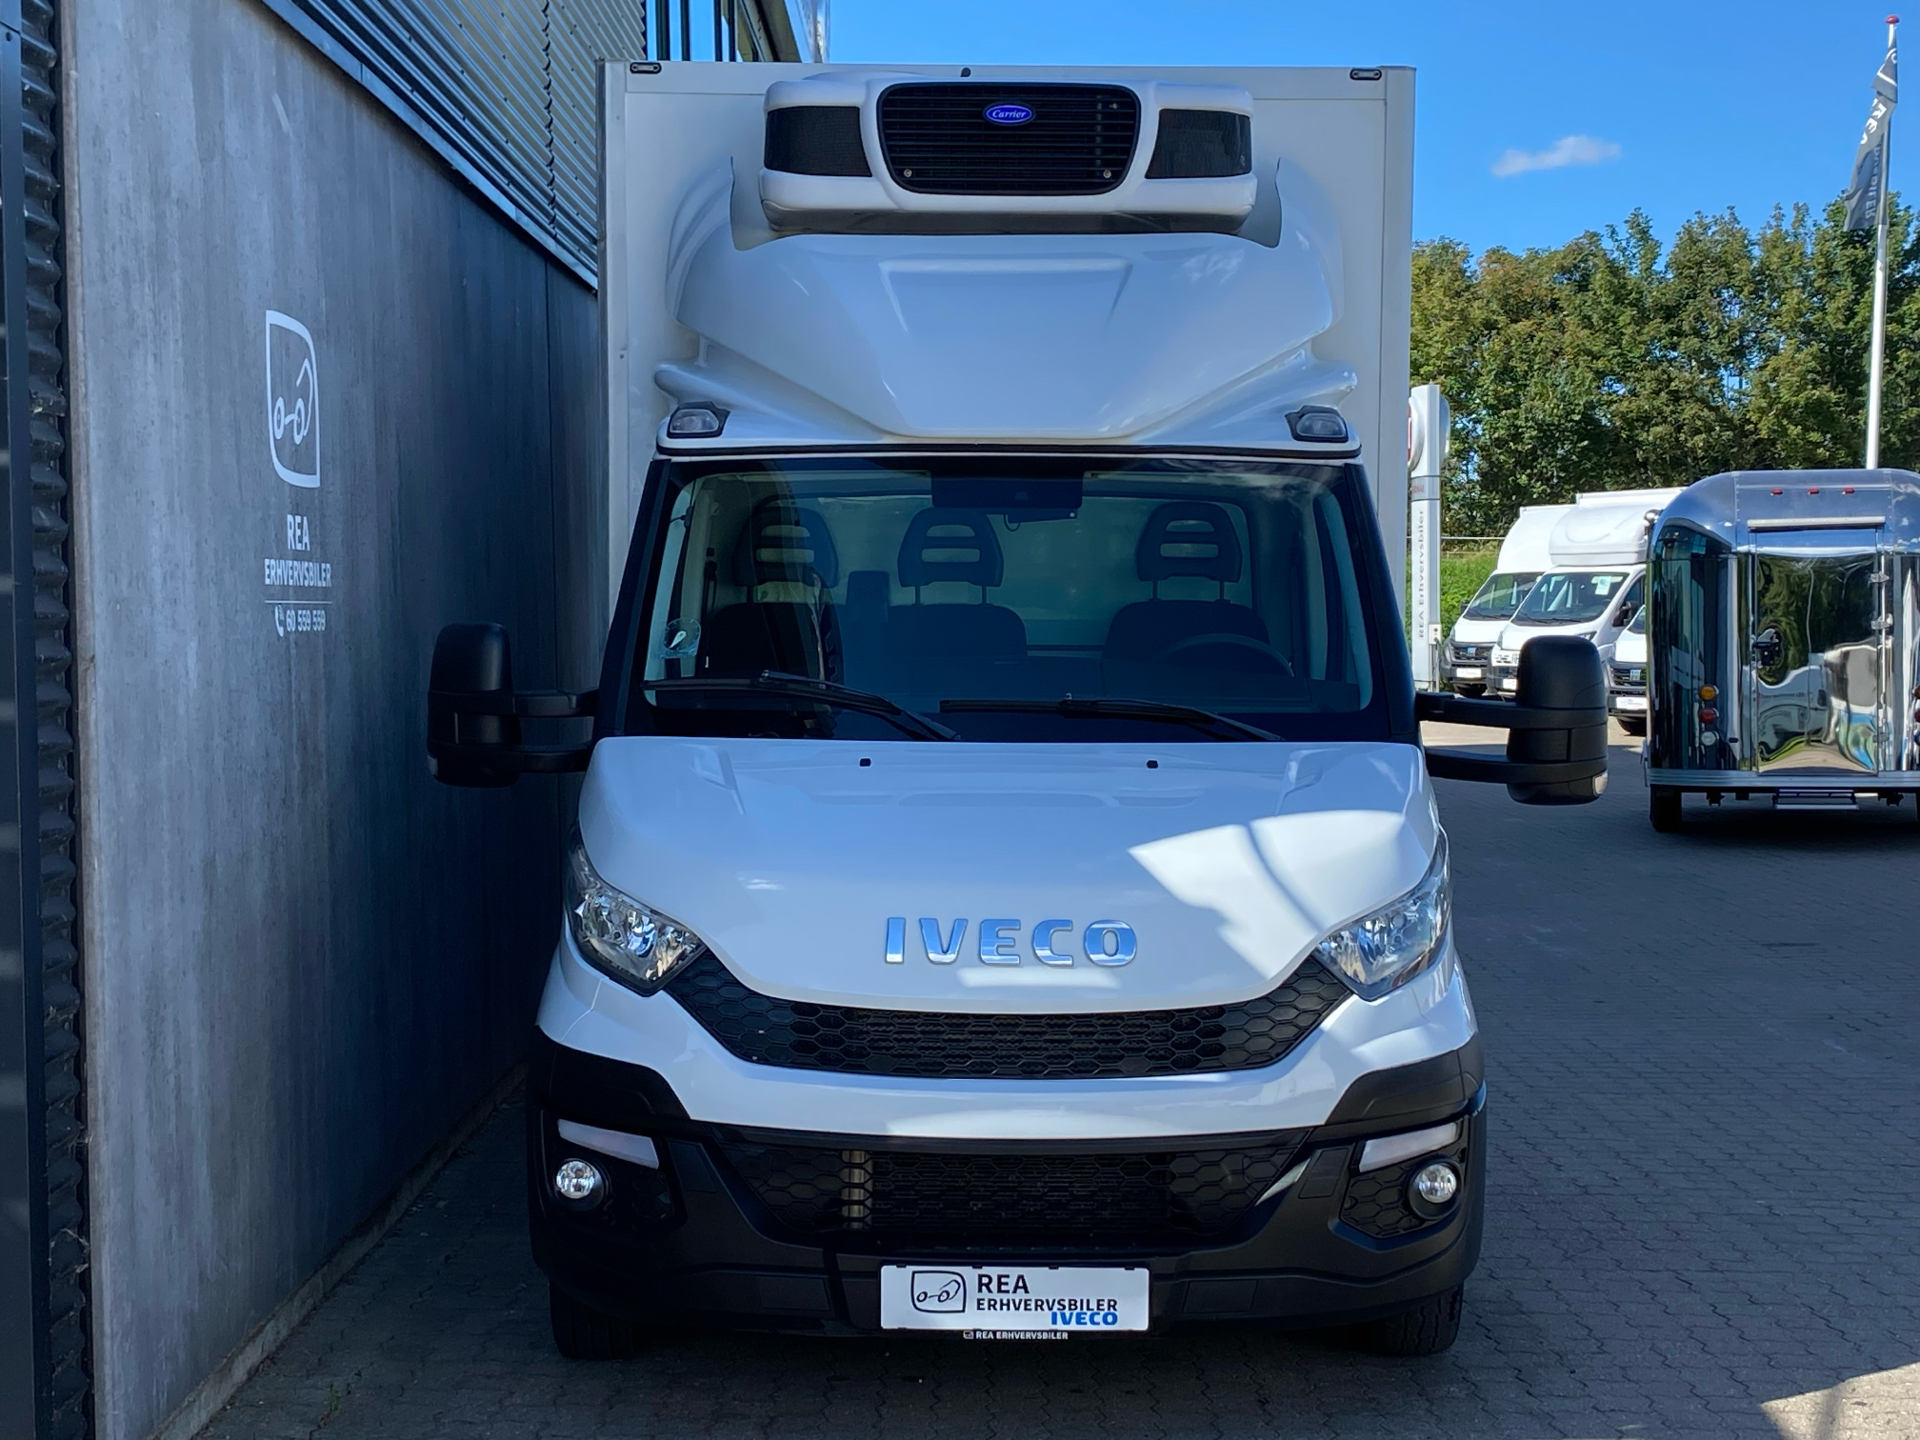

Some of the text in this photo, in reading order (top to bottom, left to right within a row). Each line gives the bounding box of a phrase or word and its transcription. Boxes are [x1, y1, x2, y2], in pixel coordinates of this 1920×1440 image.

[992, 109, 1026, 119] Carrier
[286, 514, 311, 551] REA
[1417, 510, 1425, 606] Erhvervsbiler
[264, 558, 332, 588] ERHVERVSBILER
[286, 609, 296, 632] 60
[884, 916, 1138, 968] IVECO
[977, 1274, 1030, 1294] REA
[976, 1297, 1118, 1312] ERHVERVSBILER
[1050, 1311, 1118, 1326] IVECO
[975, 1331, 1069, 1340] REA ERHVERVSBILER
